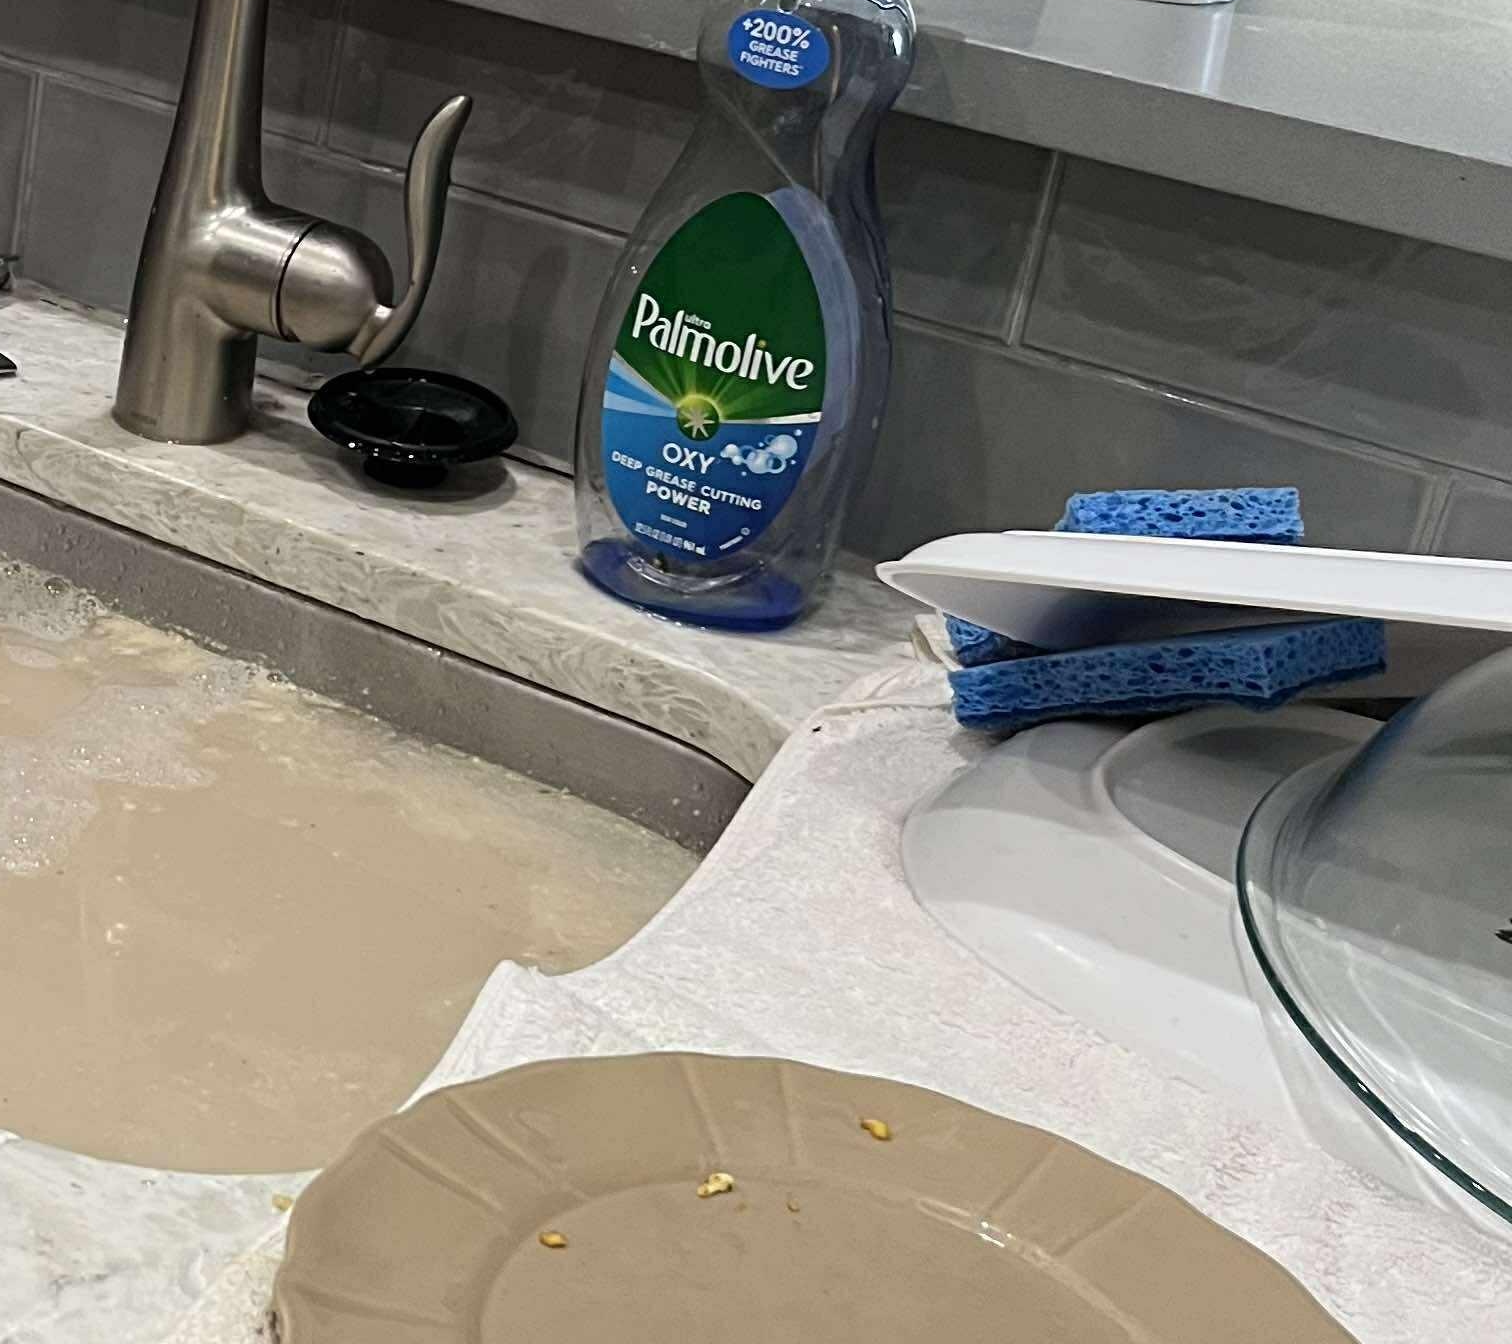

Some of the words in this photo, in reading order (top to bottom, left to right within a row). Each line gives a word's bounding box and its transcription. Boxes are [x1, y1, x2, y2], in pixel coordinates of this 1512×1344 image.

[742, 17, 811, 49] +200%
[748, 40, 800, 62] GREASE
[685, 313, 712, 330] ultra
[632, 292, 814, 390] Palmolive
[662, 442, 716, 474] OXY
[611, 451, 643, 470] DEEP
[645, 466, 697, 492] GREASE
[700, 485, 762, 511] CUTTING
[645, 480, 711, 515] POWER
